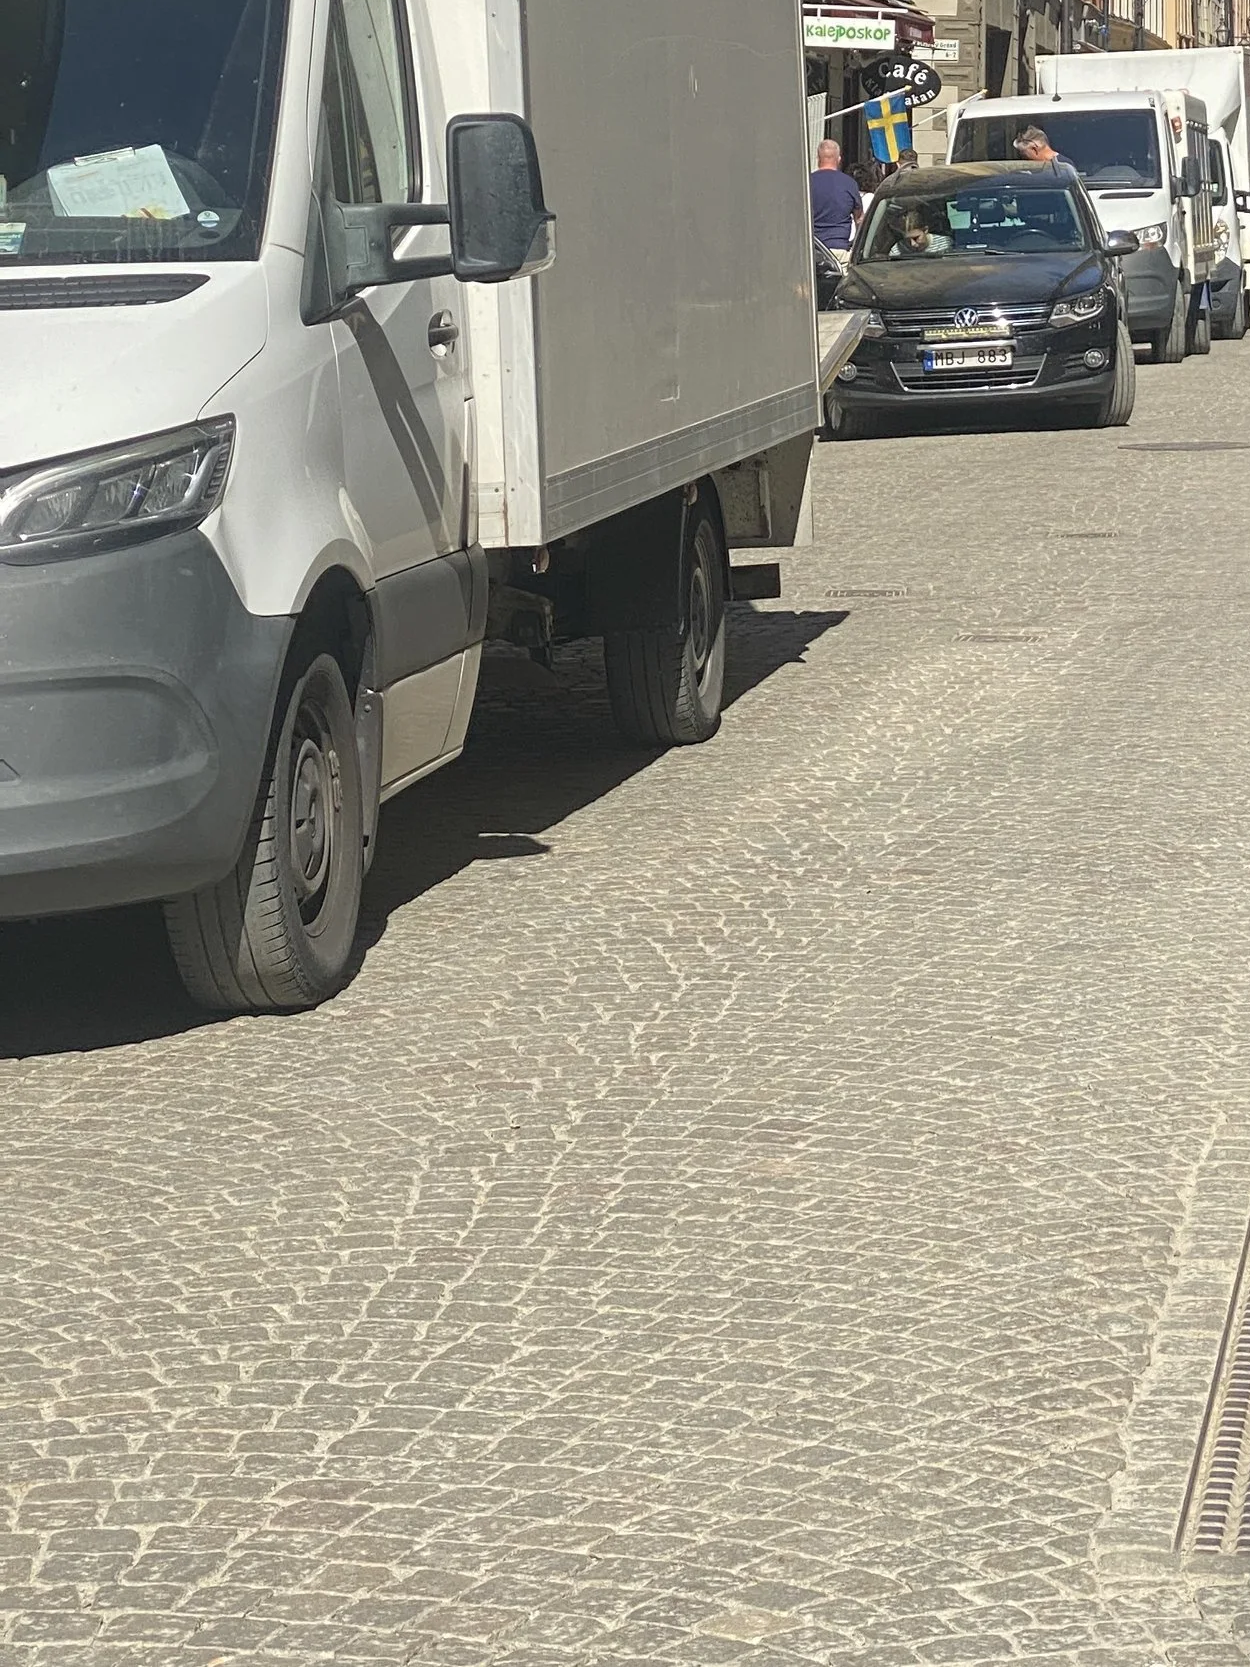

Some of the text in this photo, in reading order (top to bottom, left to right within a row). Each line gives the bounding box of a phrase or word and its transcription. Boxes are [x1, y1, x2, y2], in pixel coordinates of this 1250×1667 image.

[878, 62, 929, 86] Café
[934, 348, 1008, 366] MBJ 883
